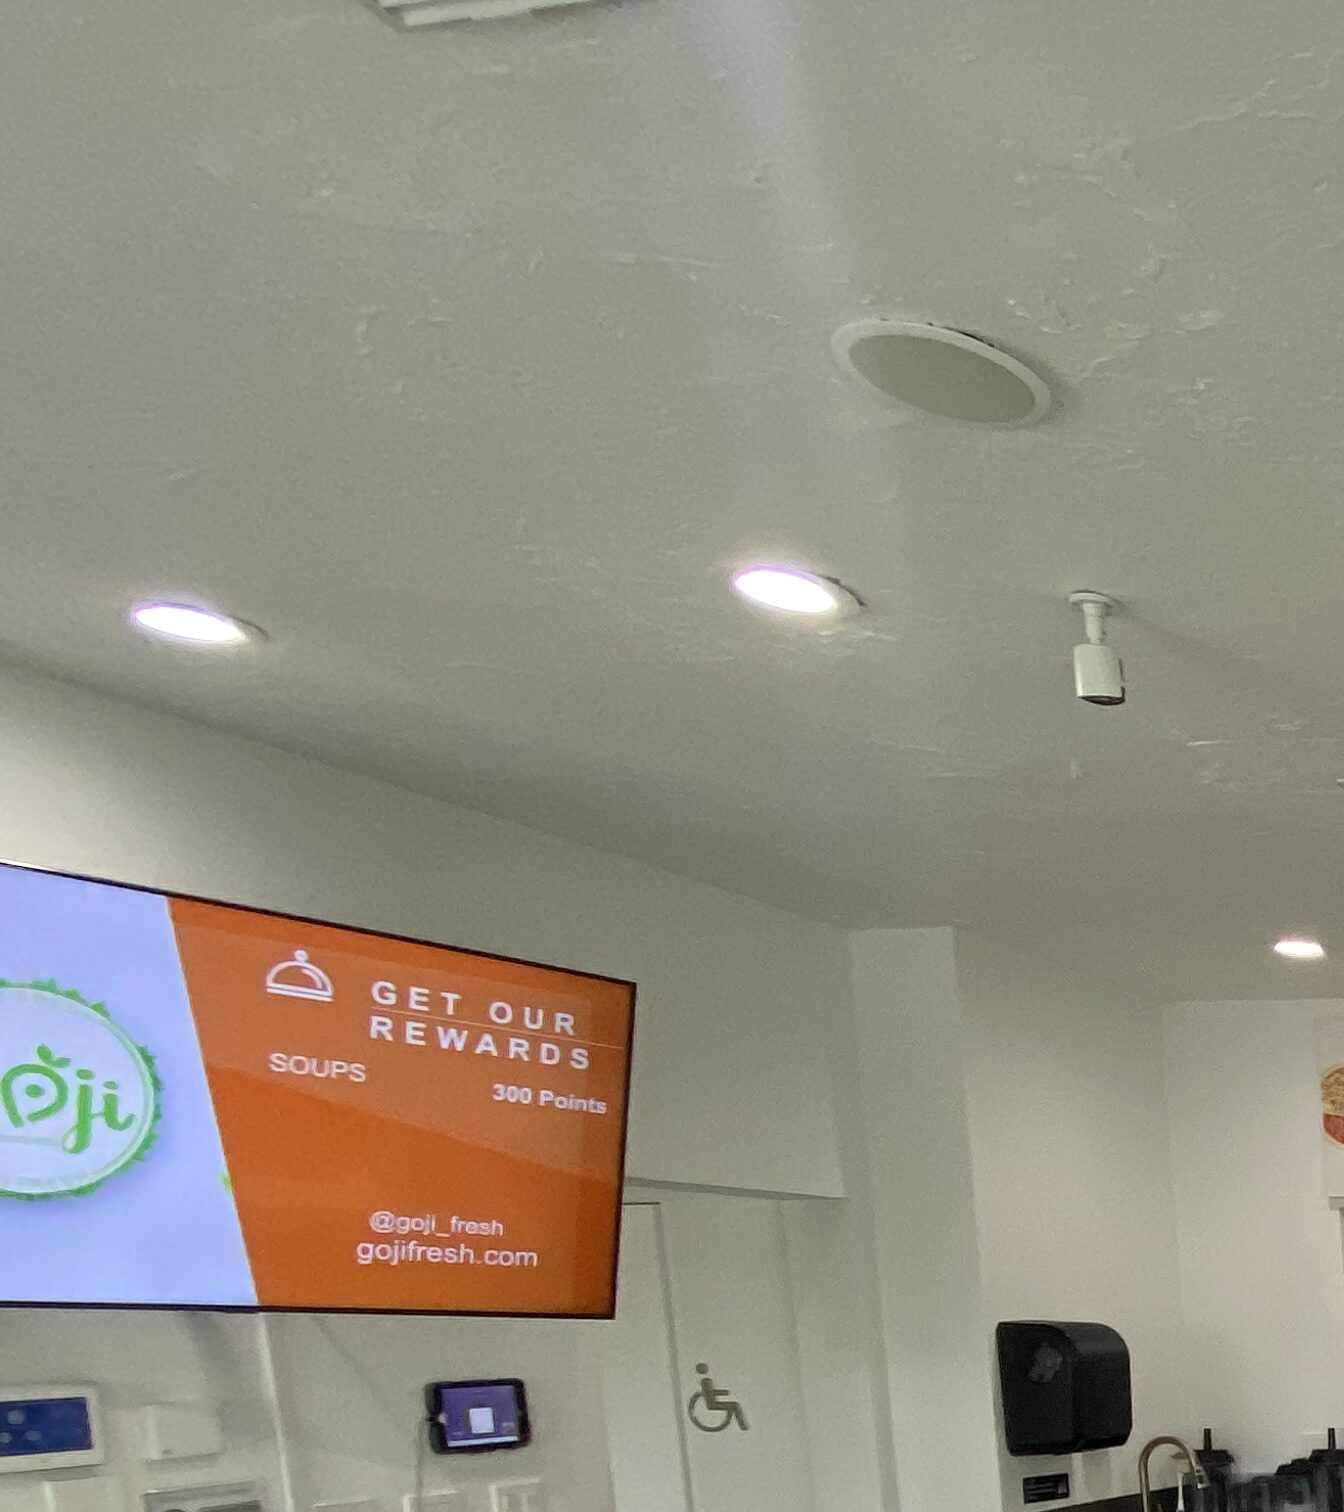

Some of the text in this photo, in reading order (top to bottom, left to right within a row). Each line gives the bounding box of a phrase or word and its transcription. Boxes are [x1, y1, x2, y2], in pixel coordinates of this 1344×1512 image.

[370, 980, 576, 1035] GET OUR
[369, 1015, 590, 1070] REWARDS
[268, 1052, 367, 1083] SOUPS
[492, 1084, 607, 1114] 300 Points
[369, 1210, 505, 1238] @goji_fresh
[356, 1240, 538, 1268] gojifresh.com
